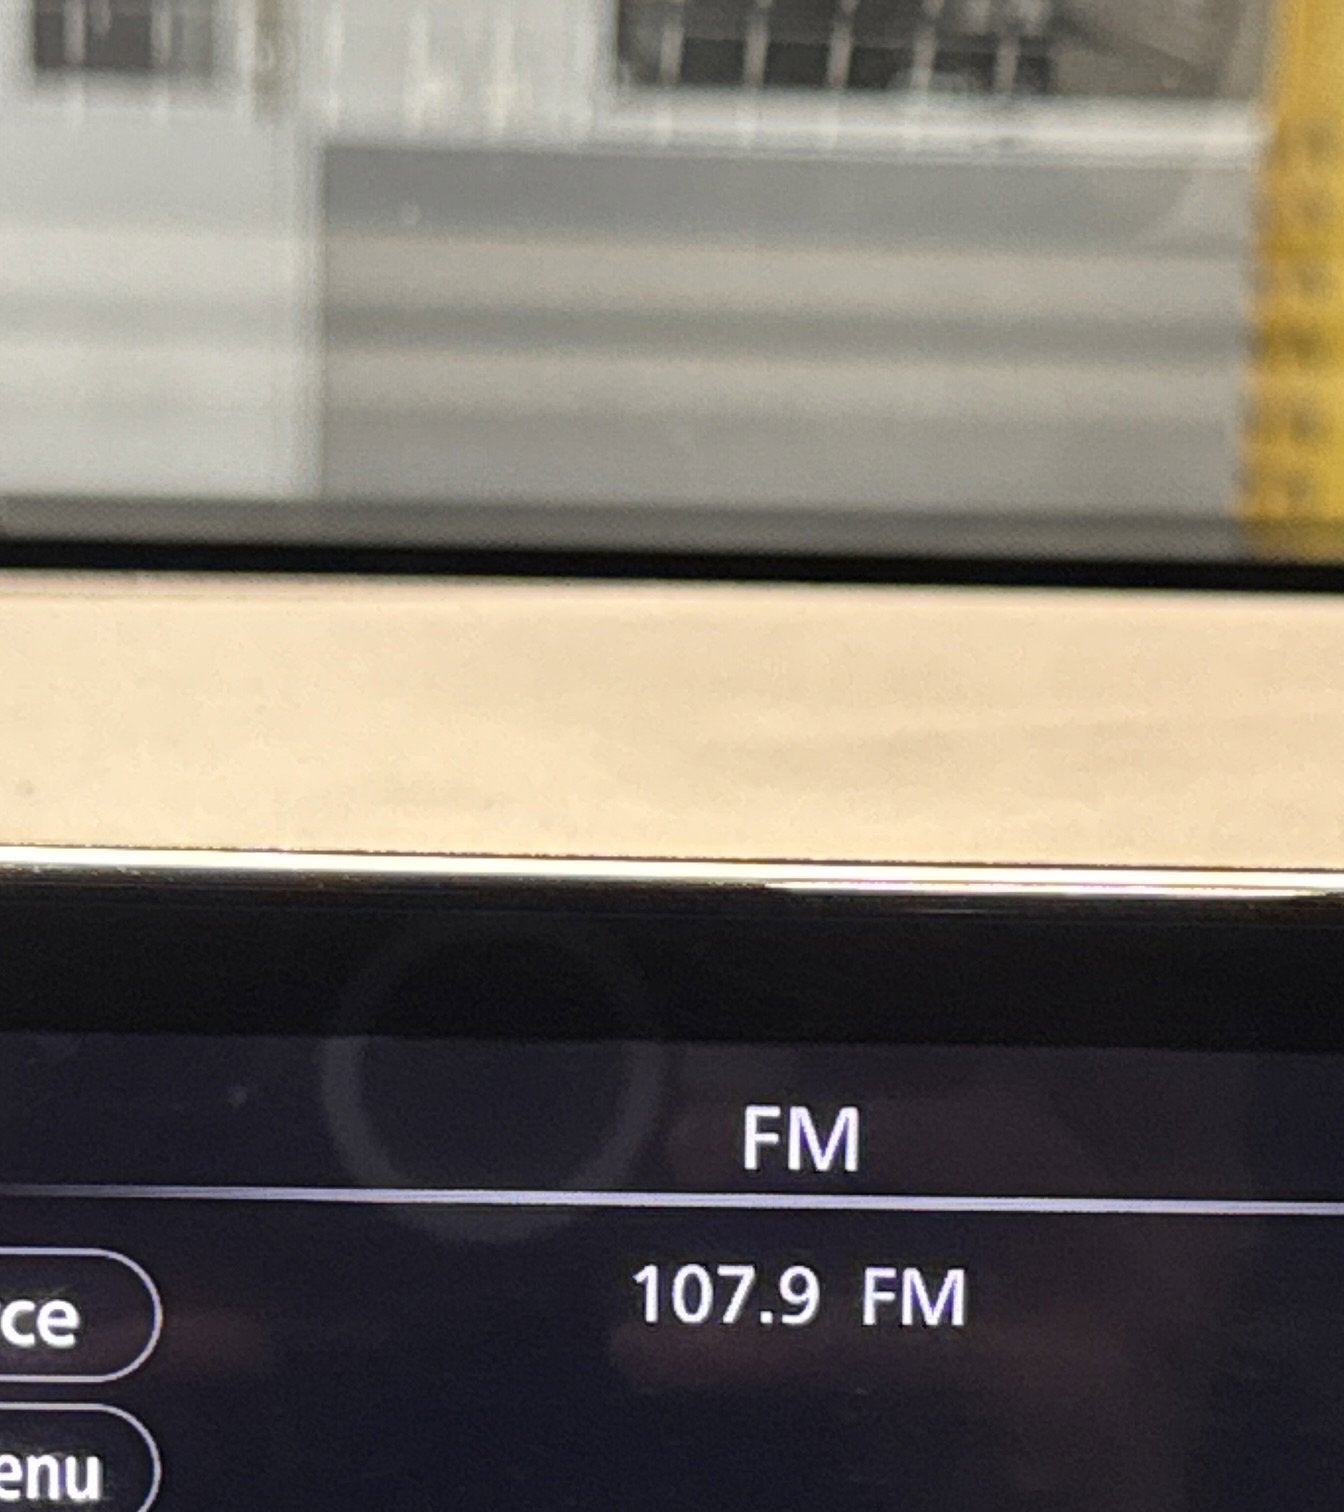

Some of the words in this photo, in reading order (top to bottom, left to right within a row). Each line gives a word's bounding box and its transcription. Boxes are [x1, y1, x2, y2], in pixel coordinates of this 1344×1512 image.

[745, 1106, 859, 1173] FM
[633, 1265, 819, 1326] 107.9
[864, 1268, 965, 1326] FM
